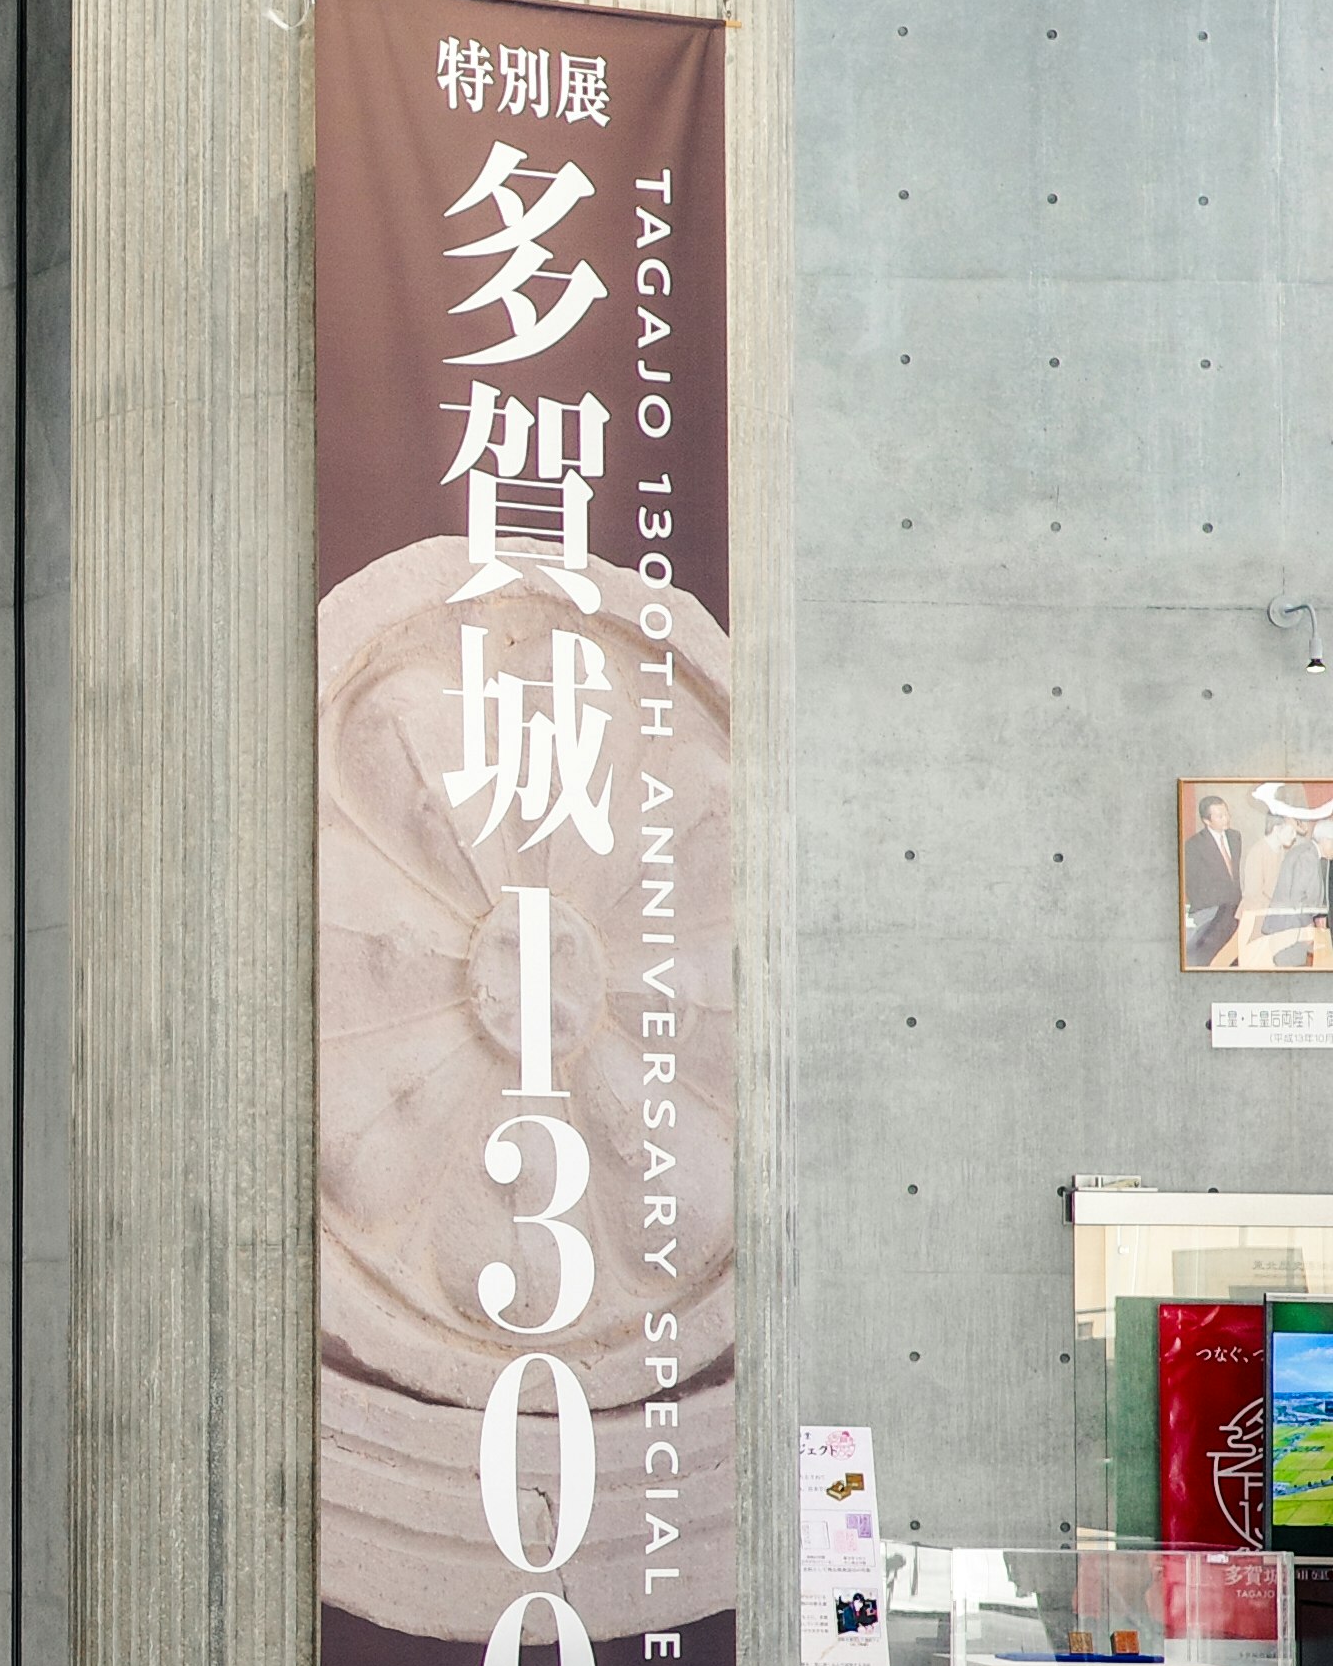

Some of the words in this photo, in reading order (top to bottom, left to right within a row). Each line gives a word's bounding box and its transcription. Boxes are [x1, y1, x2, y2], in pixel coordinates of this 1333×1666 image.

[436, 36, 612, 129] 特別展
[633, 168, 673, 440] TAGAJO
[636, 472, 676, 739] 1300TH
[639, 772, 680, 1281] ANNIVERSARY
[643, 1309, 682, 1597] SPECIAL
